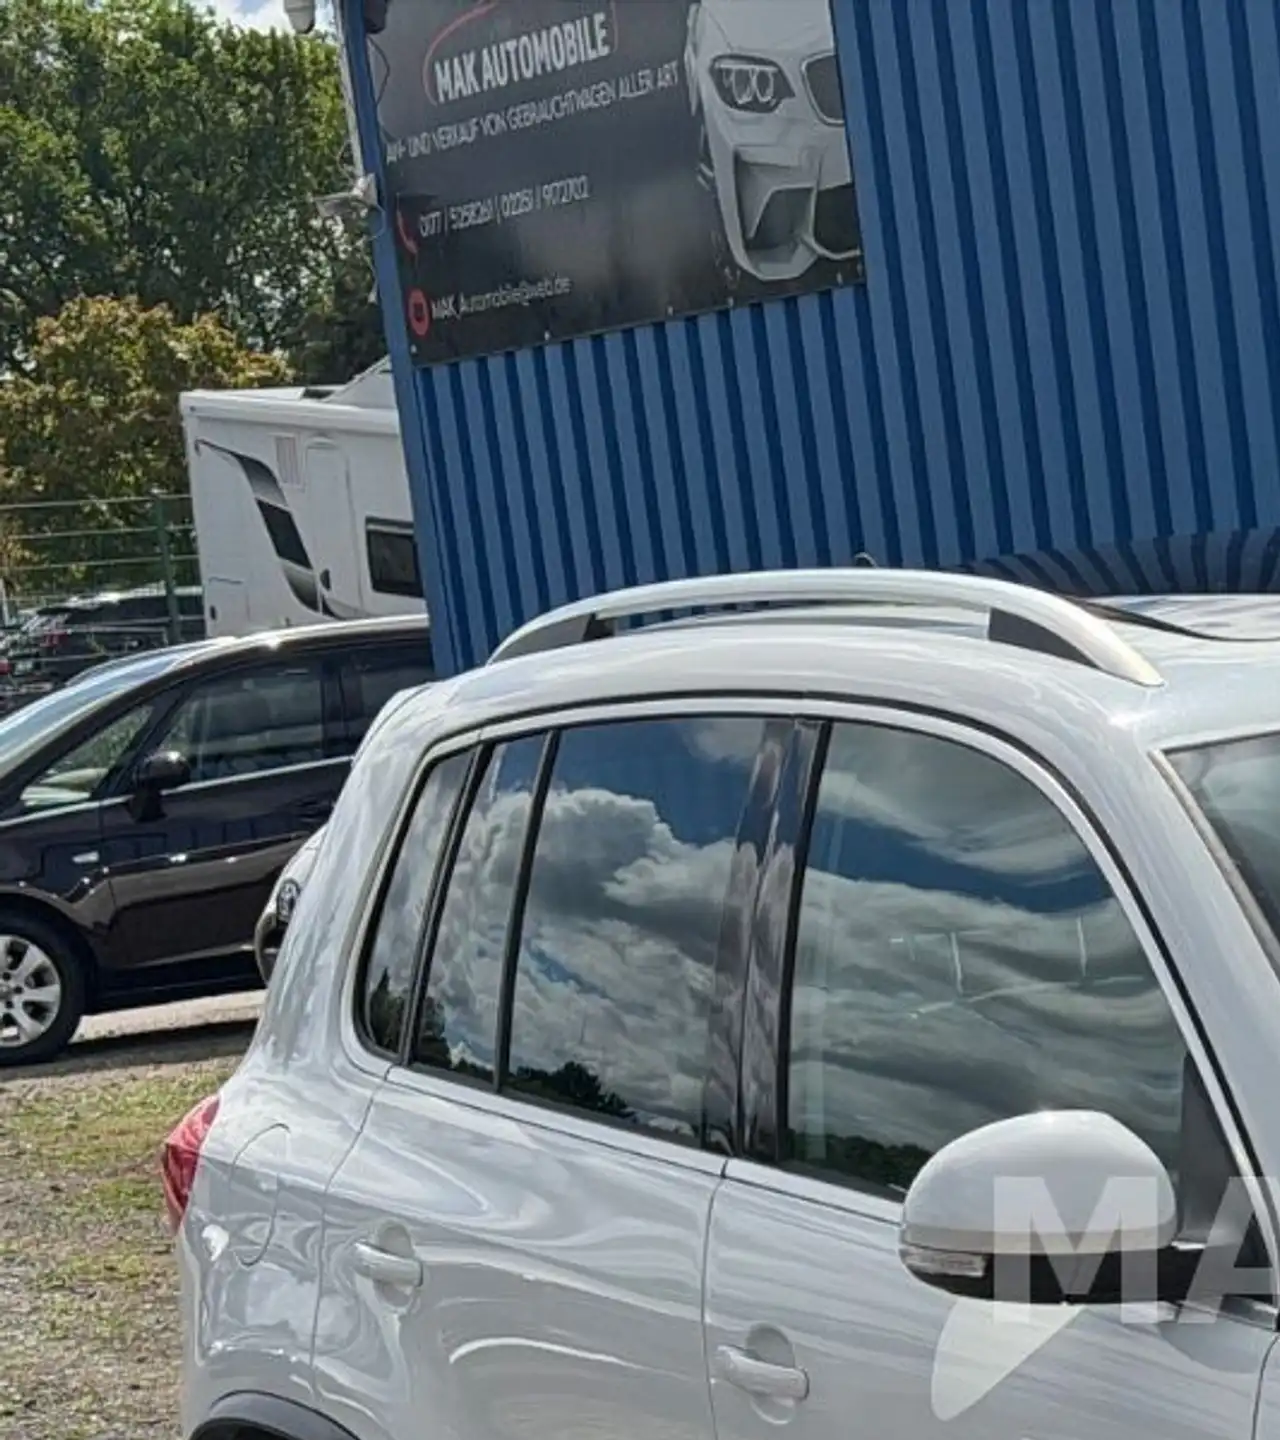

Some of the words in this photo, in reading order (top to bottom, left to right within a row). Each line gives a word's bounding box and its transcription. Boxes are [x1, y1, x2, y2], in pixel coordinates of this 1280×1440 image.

[435, 51, 481, 104] MAK
[482, 12, 610, 91] AUTOMOBILE
[432, 117, 479, 152] VERKAUF
[480, 111, 507, 137] VON
[618, 68, 655, 99] ALLER
